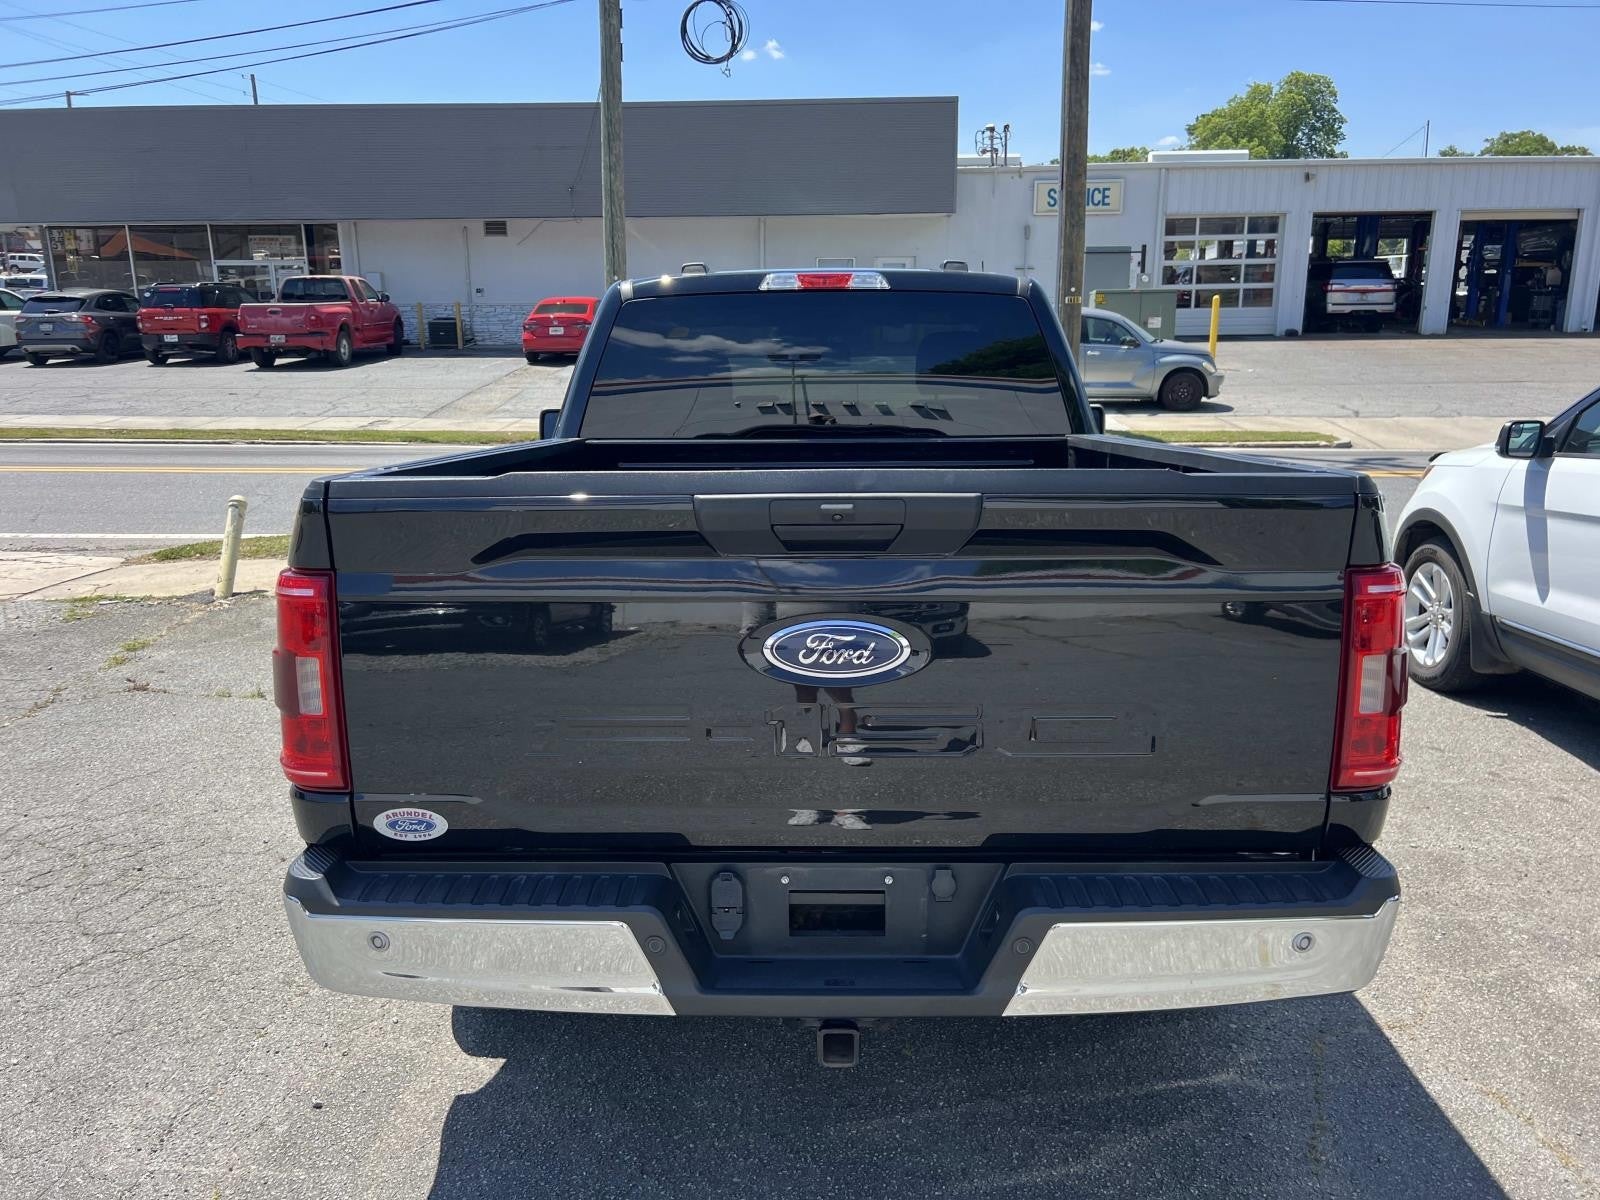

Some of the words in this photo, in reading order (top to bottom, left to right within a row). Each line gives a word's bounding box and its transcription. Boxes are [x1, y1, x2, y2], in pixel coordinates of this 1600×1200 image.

[1047, 187, 1111, 208] SICE
[798, 633, 876, 664] Ford
[385, 811, 434, 820] ARUNDEL
[395, 820, 427, 831] Ford
